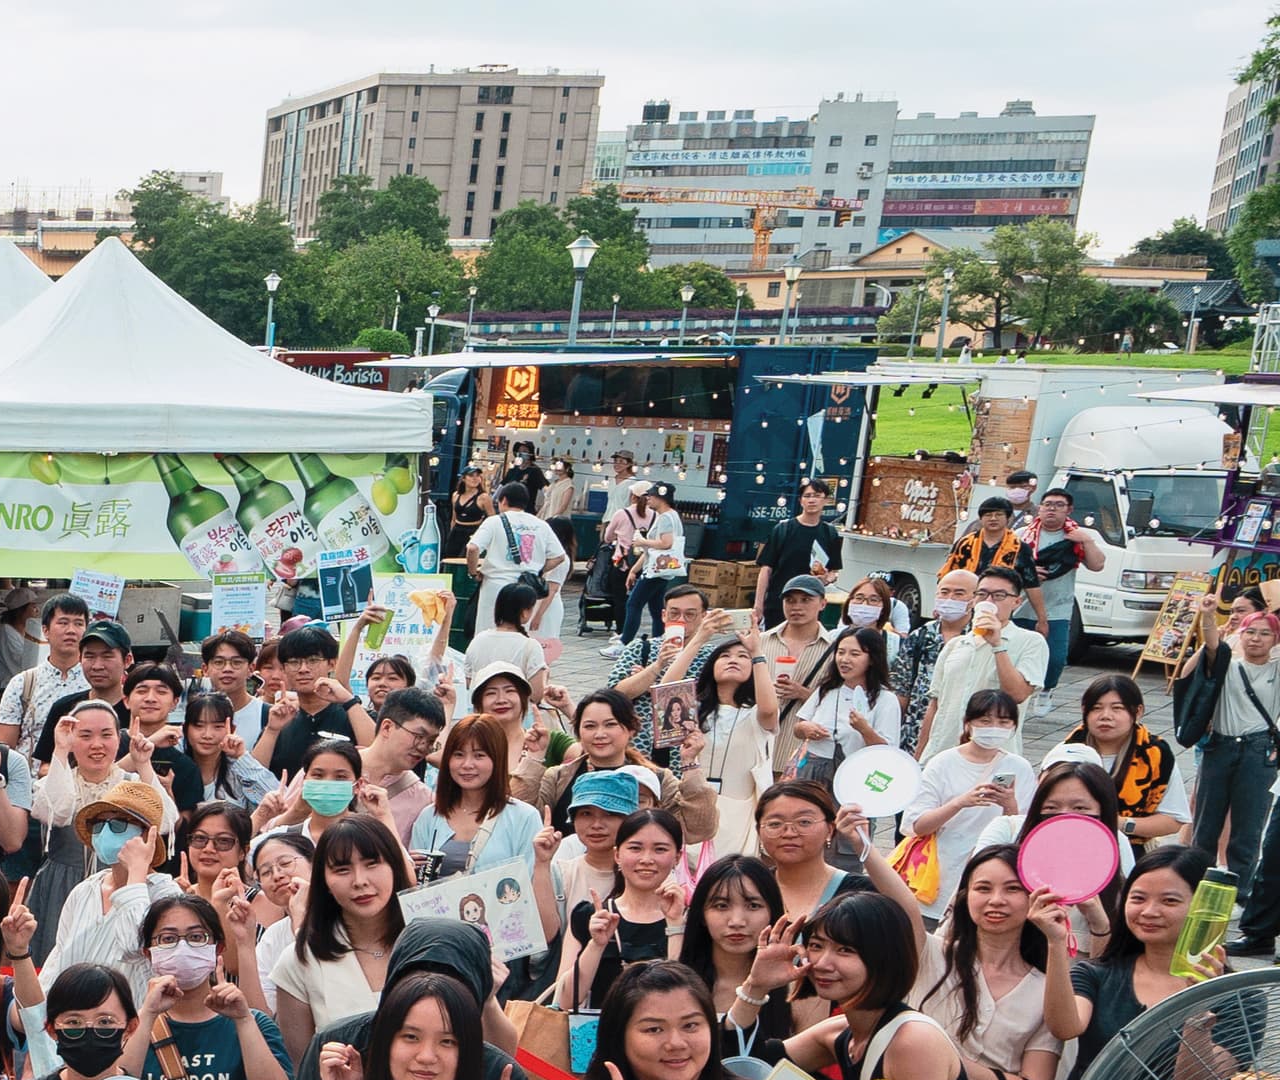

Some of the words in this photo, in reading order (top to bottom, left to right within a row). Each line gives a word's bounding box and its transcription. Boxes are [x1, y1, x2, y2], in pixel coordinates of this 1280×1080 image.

[334, 364, 383, 384] Barista
[354, 547, 369, 561] 送
[181, 1054, 216, 1068] AST
